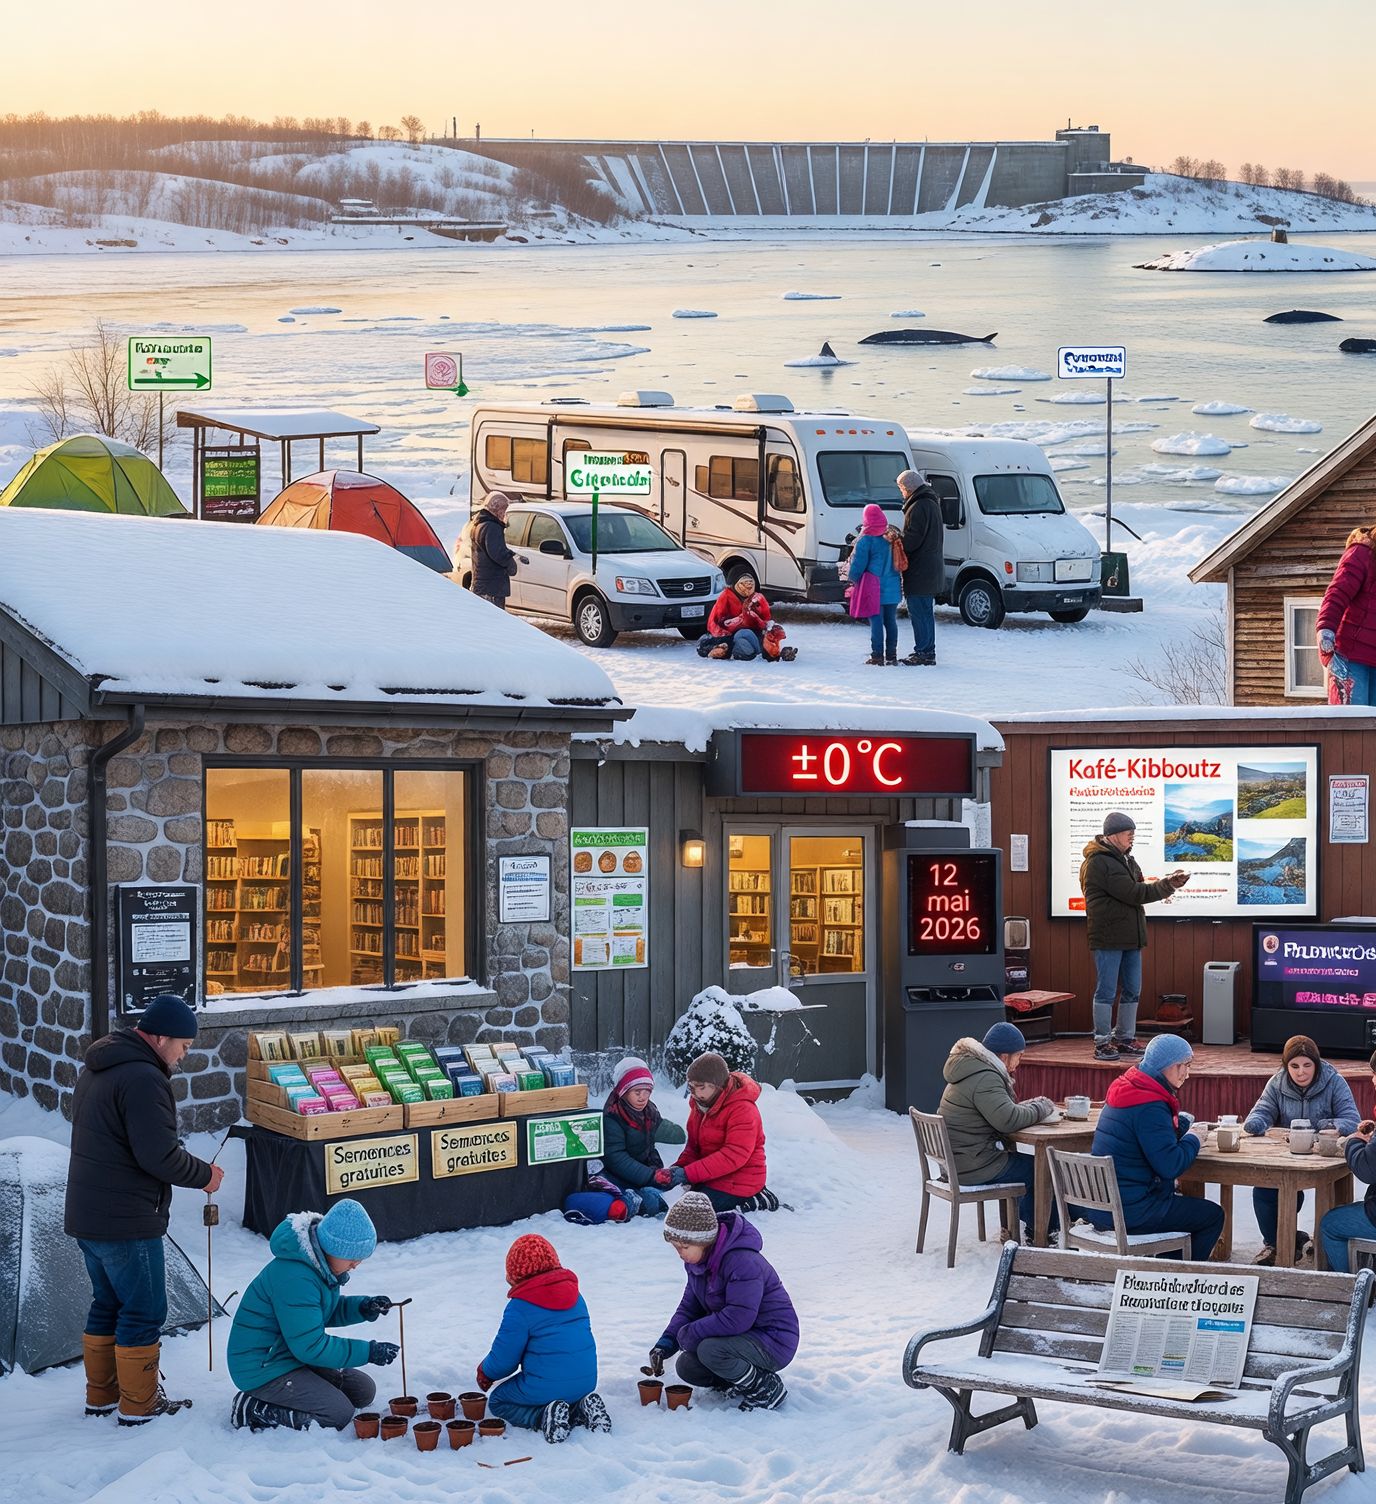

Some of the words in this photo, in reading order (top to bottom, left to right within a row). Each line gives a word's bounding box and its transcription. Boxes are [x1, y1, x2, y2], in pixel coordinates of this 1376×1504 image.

[1069, 757, 1221, 780] Kafé-Kibboutz
[930, 863, 958, 886] 12
[927, 889, 970, 912] mai
[920, 917, 981, 940] 2026
